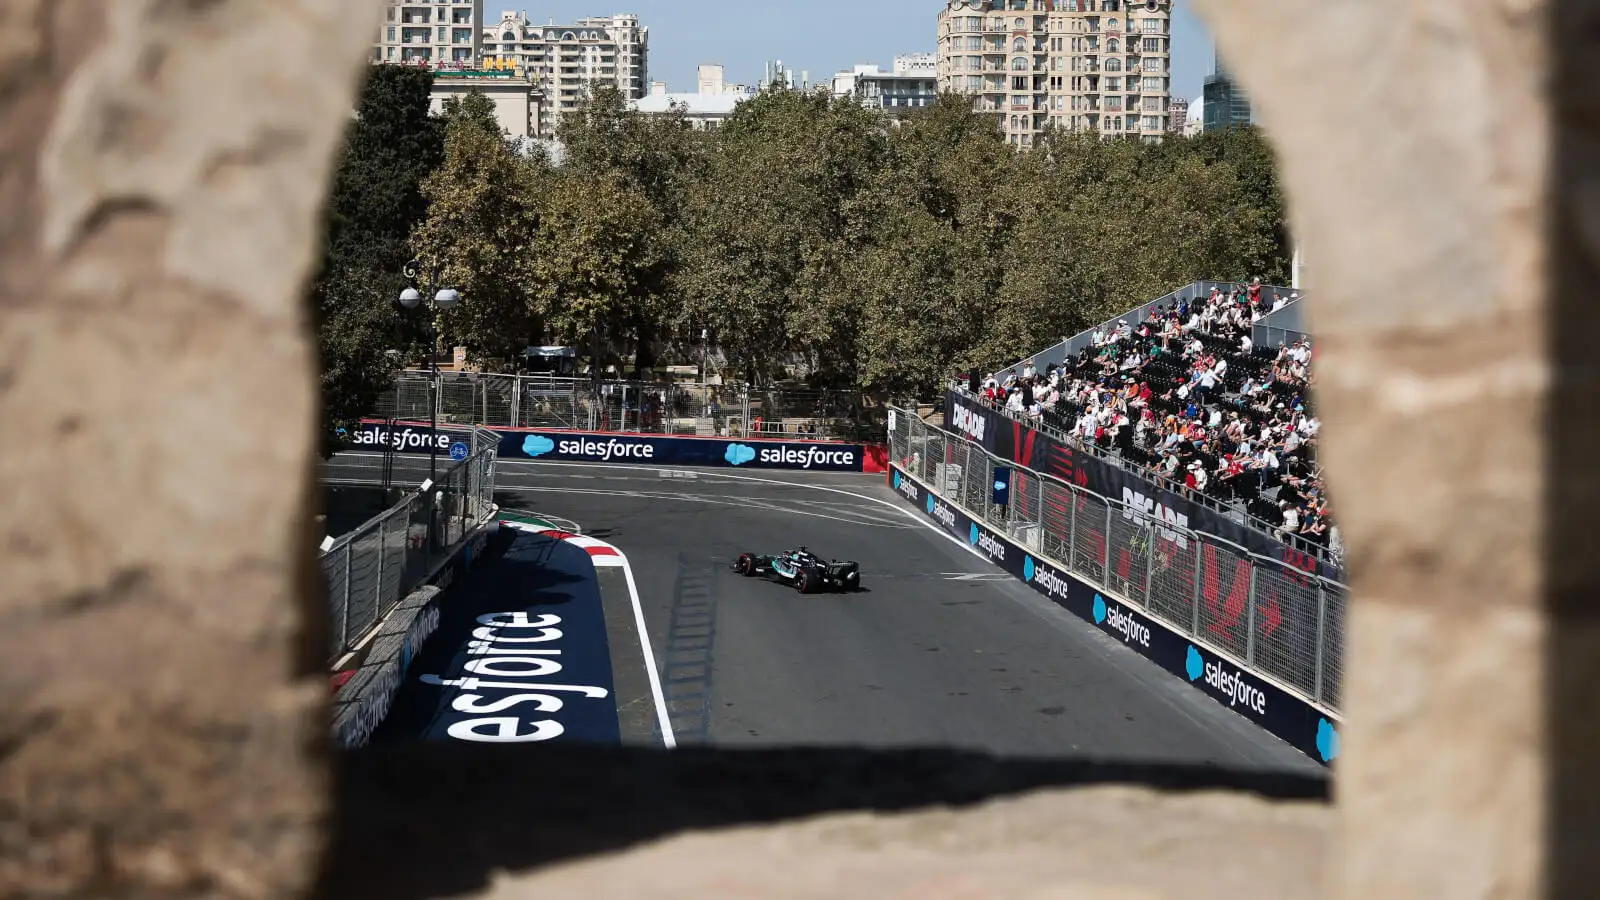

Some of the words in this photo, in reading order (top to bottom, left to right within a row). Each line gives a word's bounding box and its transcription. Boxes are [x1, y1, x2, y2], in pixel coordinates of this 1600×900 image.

[953, 403, 985, 440] DECADE
[353, 427, 449, 450] salesforce
[559, 437, 653, 460] salesforce
[760, 446, 853, 468] salesforce
[900, 476, 918, 500] salesforce
[934, 500, 955, 527] salesforce
[1123, 486, 1188, 550] DECADE
[979, 530, 1005, 560] salesforce
[1034, 563, 1068, 599] salesforce
[1107, 605, 1150, 647] salesforce
[1205, 661, 1266, 714] salesforce
